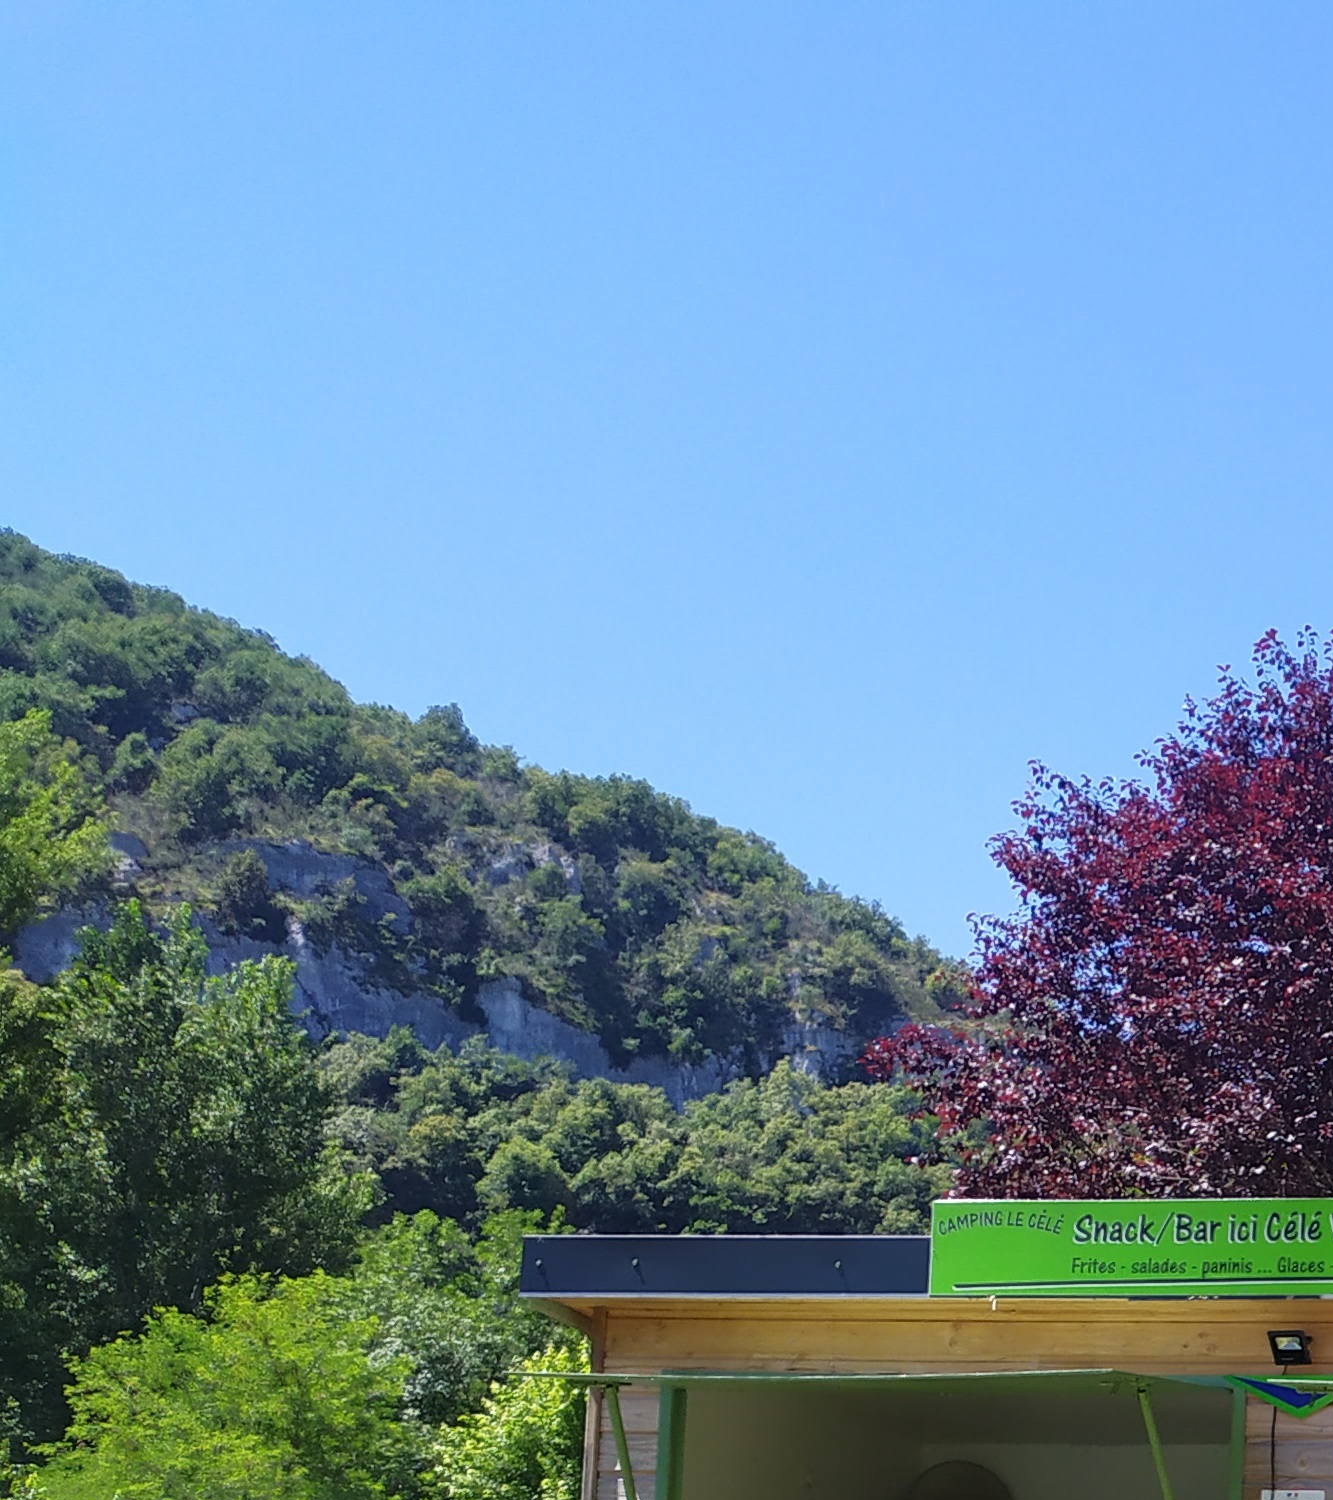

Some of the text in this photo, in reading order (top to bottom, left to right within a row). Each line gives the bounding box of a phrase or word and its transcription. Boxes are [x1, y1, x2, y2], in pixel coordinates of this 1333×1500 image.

[938, 1210, 1003, 1236] CAMPING
[1006, 1211, 1025, 1227] LE
[1072, 1211, 1222, 1247] Snack/Bar
[1227, 1213, 1258, 1244] ici
[1263, 1211, 1323, 1244] Célé
[1071, 1257, 1116, 1274] Frites
[1131, 1257, 1187, 1275] salades
[1202, 1257, 1254, 1279] paninis
[1277, 1256, 1325, 1274] Glaces
